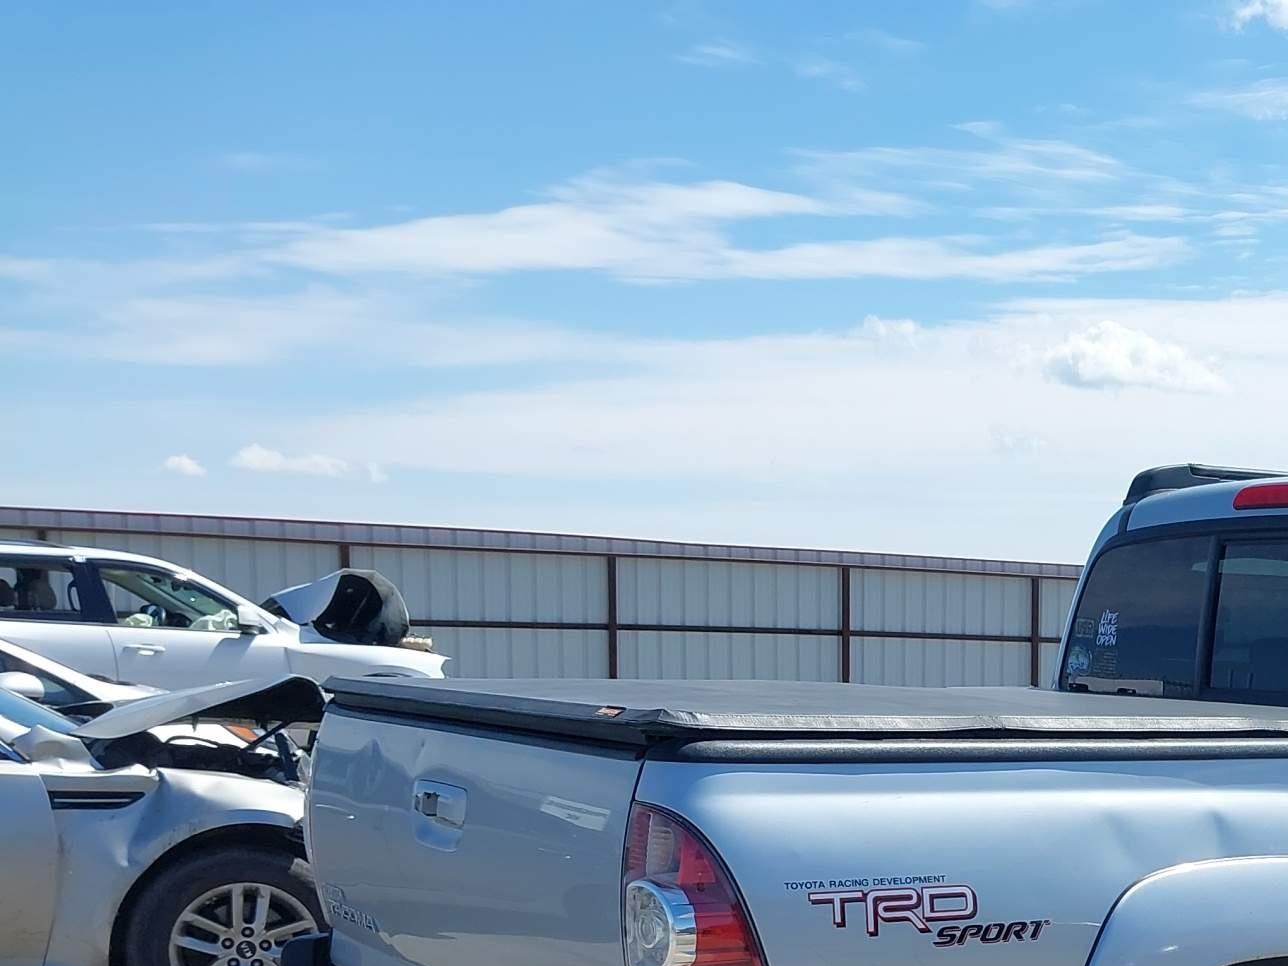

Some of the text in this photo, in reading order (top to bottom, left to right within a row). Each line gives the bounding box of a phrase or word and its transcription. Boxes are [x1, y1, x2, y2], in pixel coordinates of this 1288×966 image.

[1101, 609, 1119, 624] LIFE
[1098, 623, 1117, 635] WIDE
[1096, 634, 1117, 646] OPEN
[784, 875, 947, 890] TOYOTA RACING DEVELOPMENT
[808, 886, 978, 936] TRD
[933, 920, 1051, 947] SPORT
